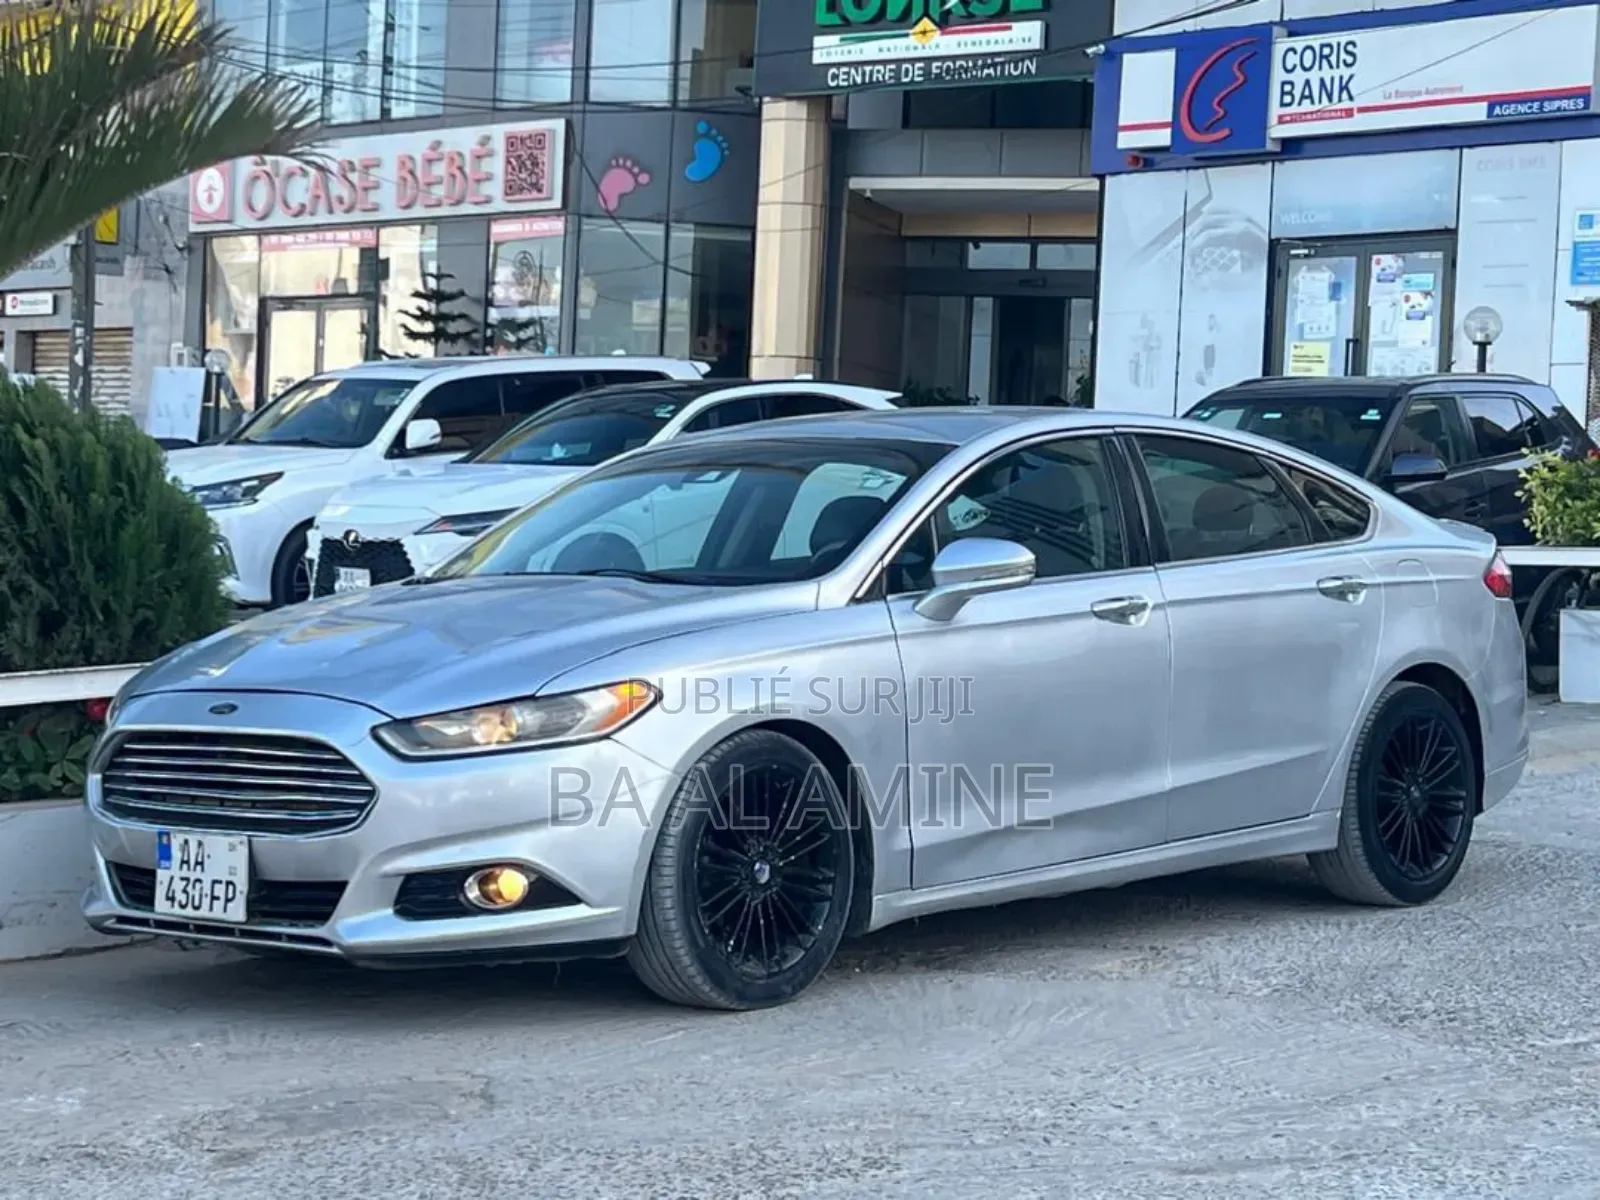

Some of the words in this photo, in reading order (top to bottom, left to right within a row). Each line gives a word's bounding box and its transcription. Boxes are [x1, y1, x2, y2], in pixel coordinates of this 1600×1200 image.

[827, 64, 896, 87] CENTRE
[901, 62, 925, 83] DE
[931, 57, 1037, 80] FORMATION
[1282, 40, 1358, 74] CORIS
[1279, 74, 1356, 107] BANK
[1493, 101, 1540, 116] AGENCE
[396, 134, 495, 210] BÉBÉ
